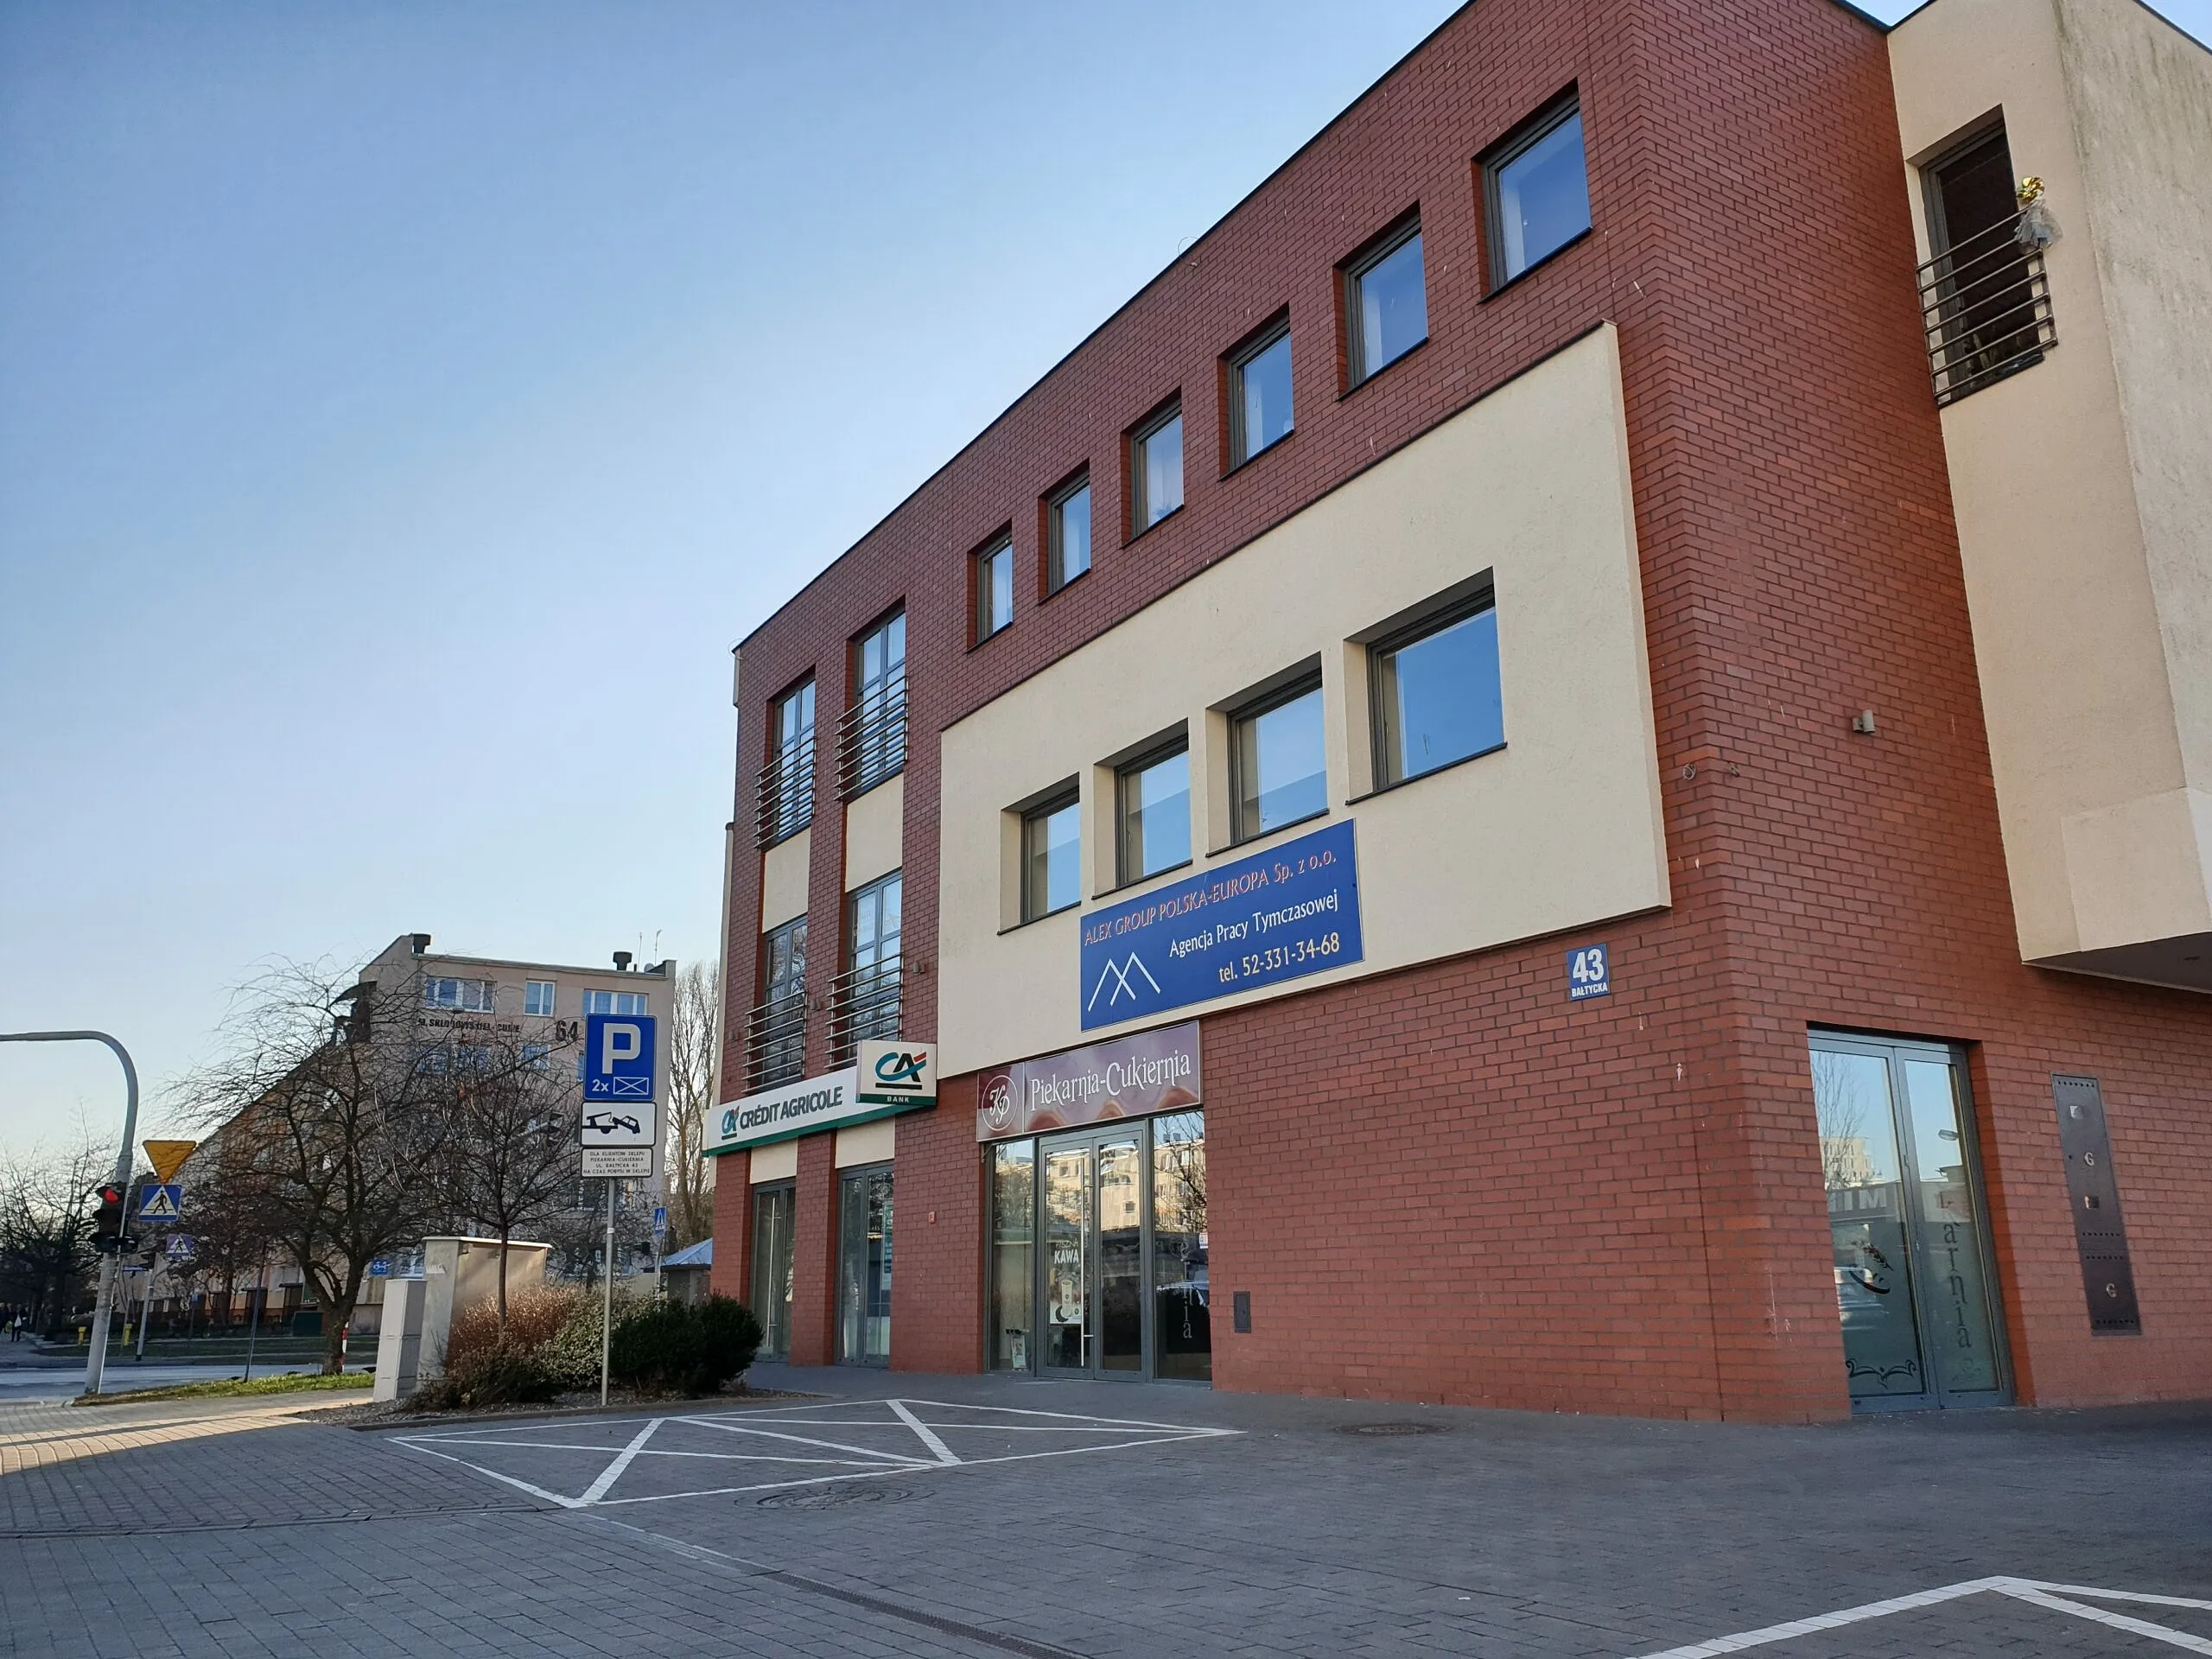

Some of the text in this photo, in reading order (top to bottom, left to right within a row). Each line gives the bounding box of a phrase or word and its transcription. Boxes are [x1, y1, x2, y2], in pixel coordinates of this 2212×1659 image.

[1084, 849, 1337, 946] ALEX GROUP POLSKA-EUROPA Sp. z o.o.
[1169, 888, 1338, 957] Agencja Pracy Tymczasowej
[1218, 931, 1340, 982] tel. 52-331-34-68
[1573, 949, 1605, 983] 43
[1572, 982, 1608, 997] BAŁTYCKA
[556, 1020, 579, 1042] 64
[602, 1023, 641, 1074] P
[592, 1079, 609, 1092] 2x
[1031, 1049, 1192, 1112] Piekarnia-Cukiernia
[741, 1103, 780, 1129] CRÉDIT
[780, 1085, 843, 1120] AGRICOLE
[1054, 1249, 1080, 1264] KAWA
